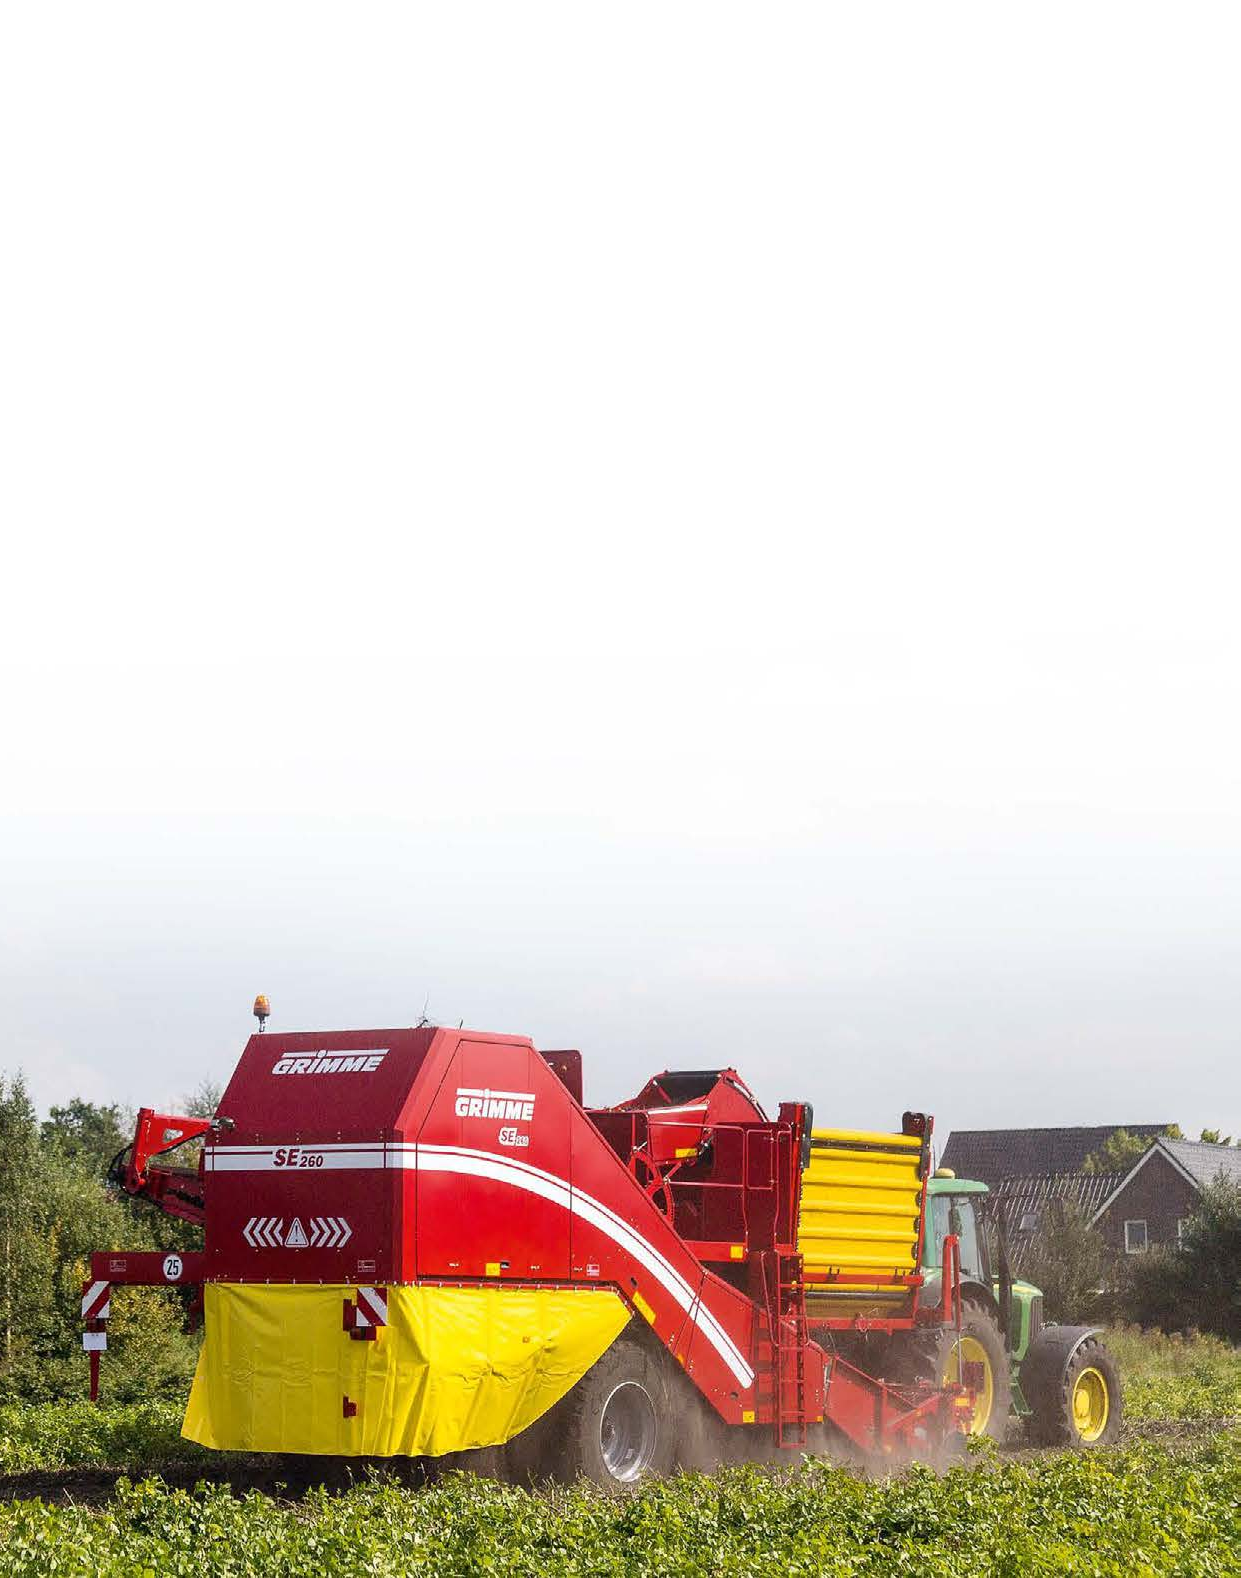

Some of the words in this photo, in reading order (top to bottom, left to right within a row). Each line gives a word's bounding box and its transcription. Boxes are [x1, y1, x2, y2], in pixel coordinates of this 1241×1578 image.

[272, 1050, 387, 1074] GRIMME
[455, 1088, 535, 1121] GRIMME
[501, 1130, 515, 1142] SE
[167, 1260, 179, 1275] 25
